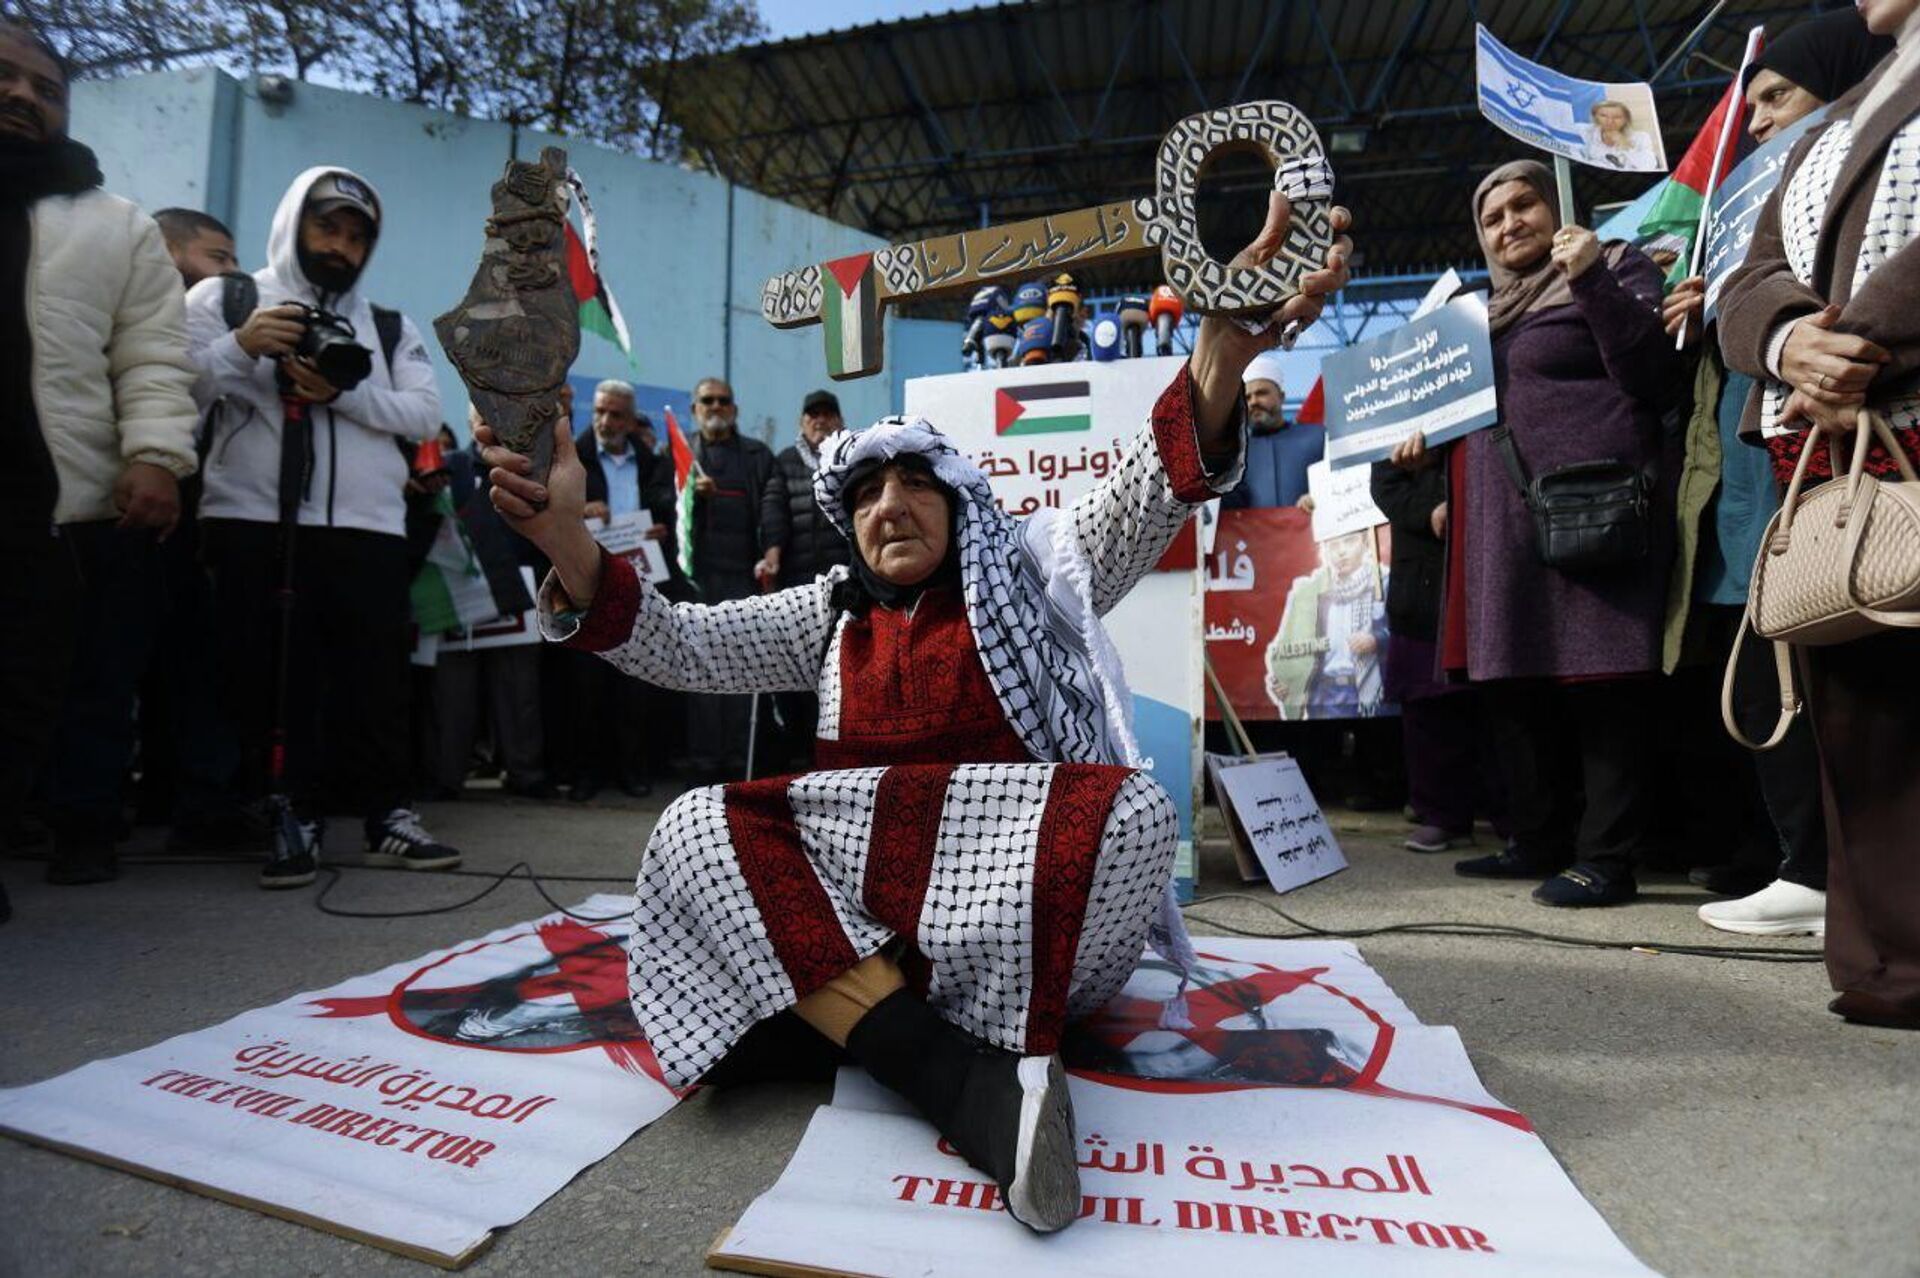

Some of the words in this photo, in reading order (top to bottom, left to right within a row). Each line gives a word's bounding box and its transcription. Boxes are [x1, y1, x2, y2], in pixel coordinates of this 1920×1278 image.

[921, 233, 968, 287] لنا
[976, 206, 1130, 277] فلسطين
[141, 1069, 230, 1098] THE
[205, 1085, 306, 1118] EVIL
[287, 1103, 496, 1168] DIRECTOR
[378, 1068, 557, 1123] المديرة
[1184, 1145, 1432, 1195] المديرة
[1174, 1200, 1496, 1253] DIRECTOR
